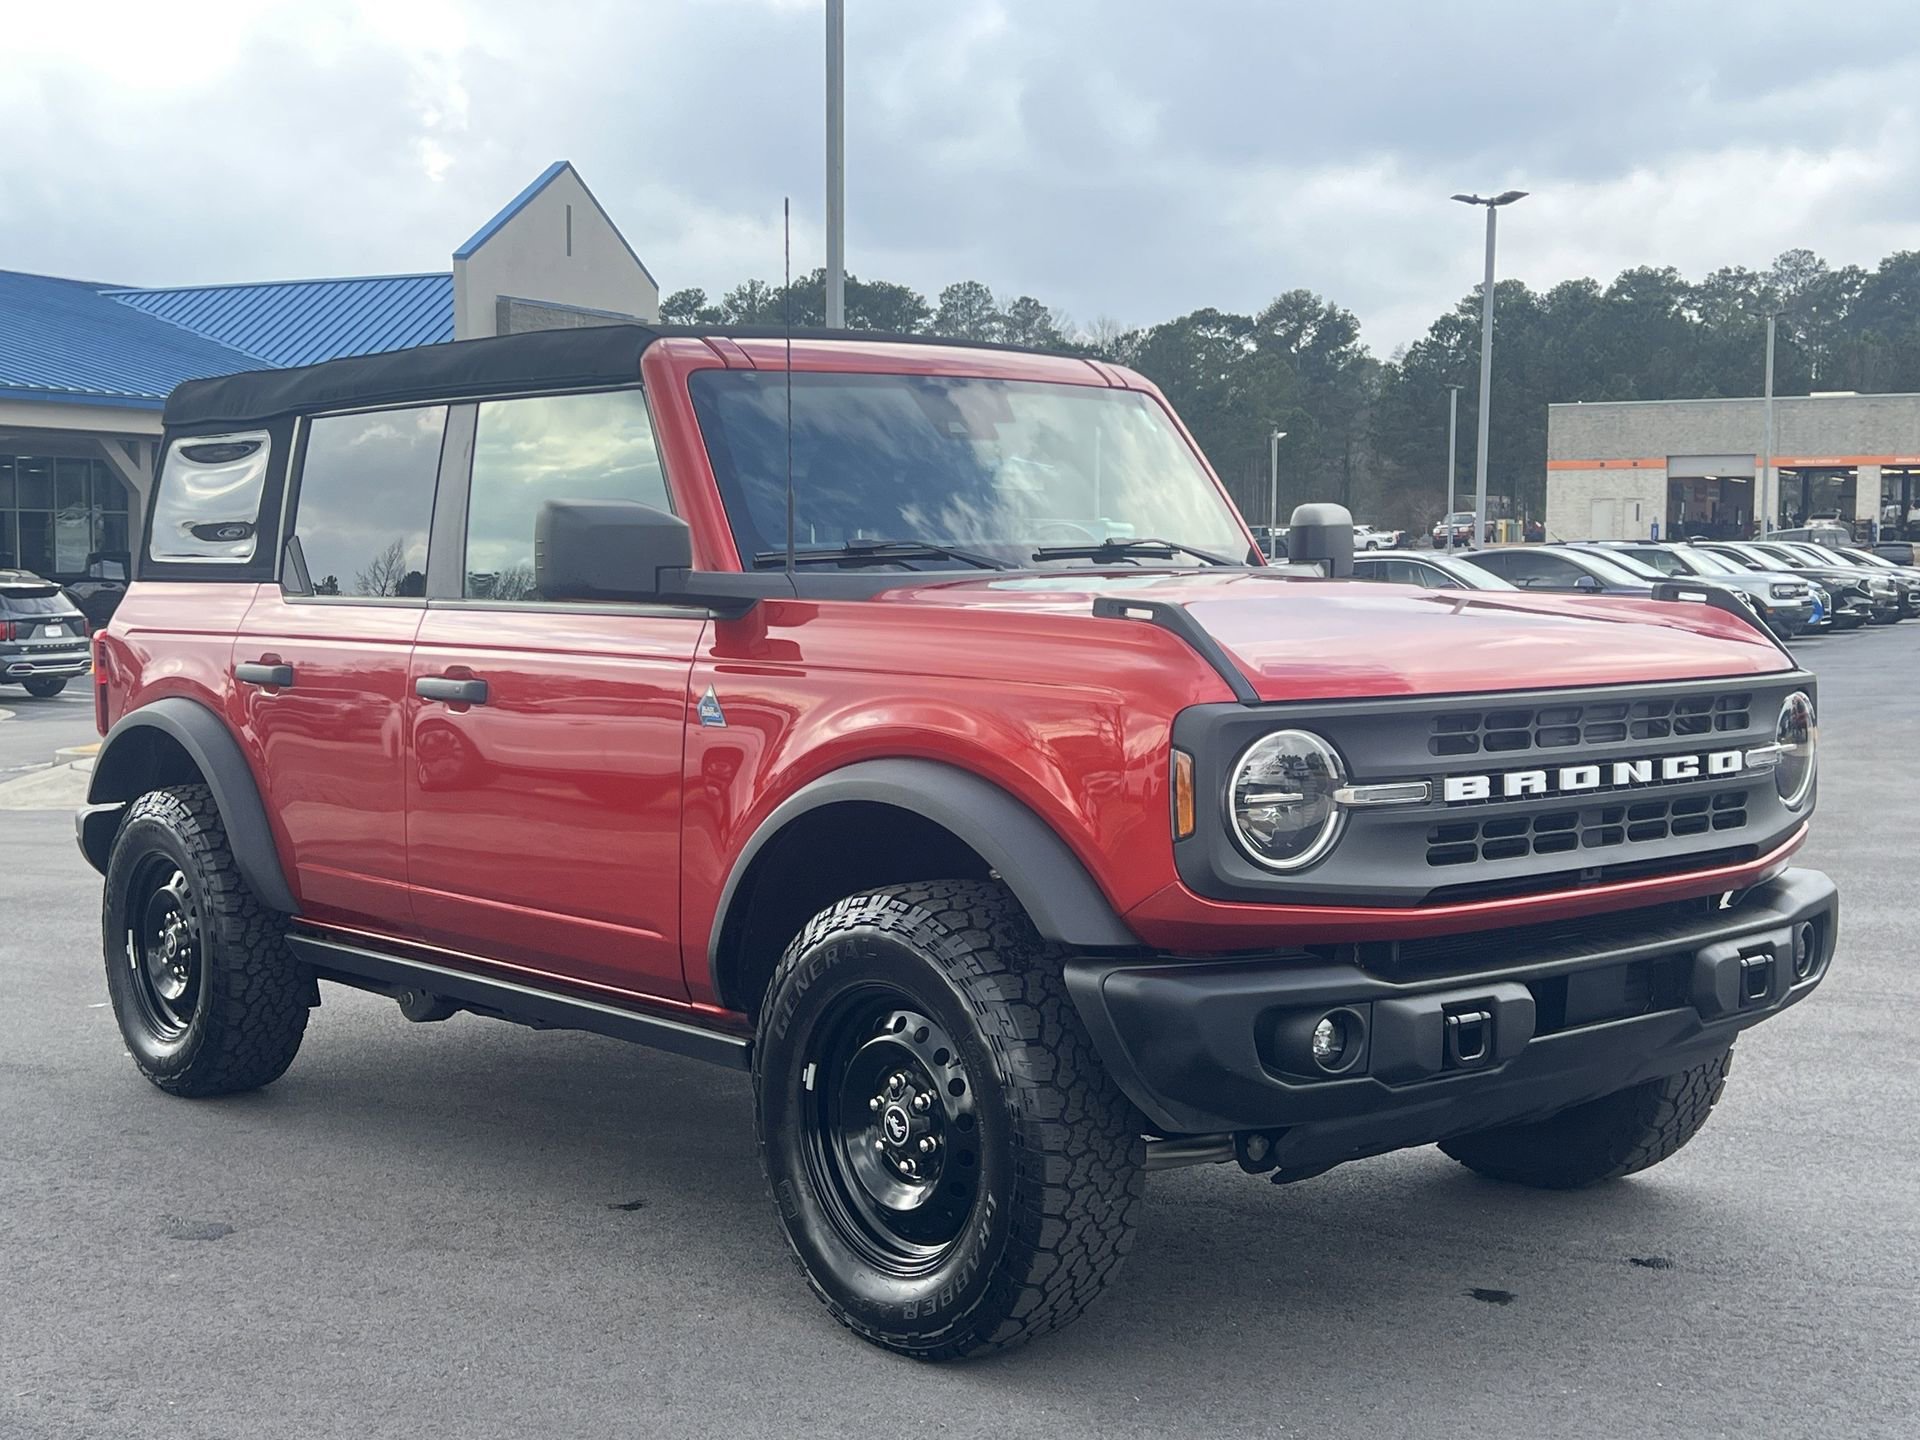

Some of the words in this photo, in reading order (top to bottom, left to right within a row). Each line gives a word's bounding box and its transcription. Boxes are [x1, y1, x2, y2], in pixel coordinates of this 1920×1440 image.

[1444, 750, 1743, 802] BRONCO
[774, 938, 878, 1041] GENERAL
[902, 1191, 997, 1320] GRABBER
